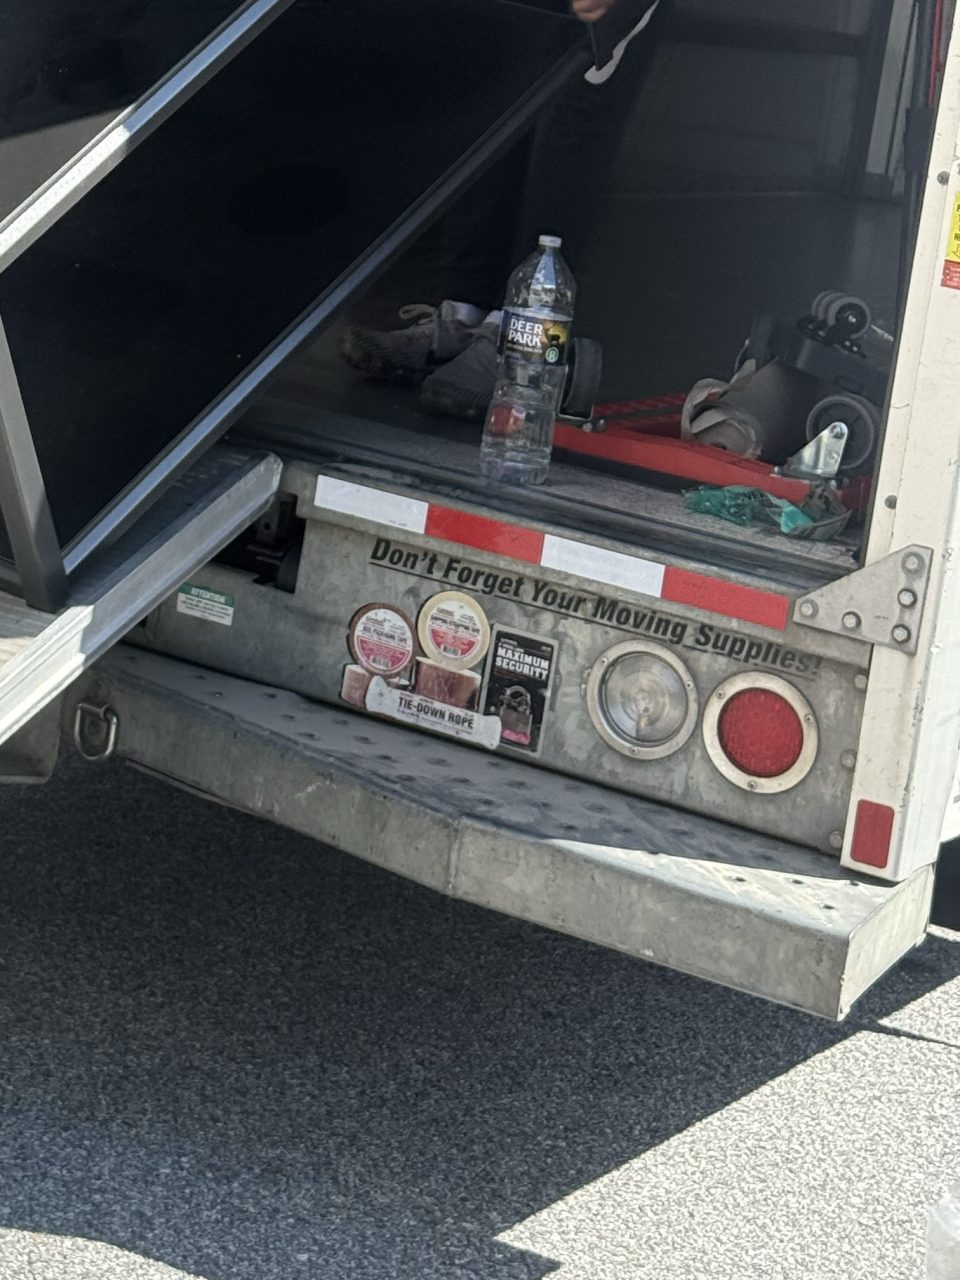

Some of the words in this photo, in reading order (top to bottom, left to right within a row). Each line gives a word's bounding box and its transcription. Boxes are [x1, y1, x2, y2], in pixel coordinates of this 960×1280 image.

[508, 329, 542, 348] PARK
[510, 318, 544, 336] DEER
[371, 538, 439, 575] Don't
[443, 558, 525, 596] Forget
[530, 580, 588, 613] Your
[592, 597, 688, 645] Moving
[695, 624, 825, 675] Supplies!
[495, 656, 549, 679] SECURITY
[497, 646, 550, 670] MAXIMUM
[398, 696, 446, 720] TIE-DOWN
[447, 712, 475, 729] ROPE
